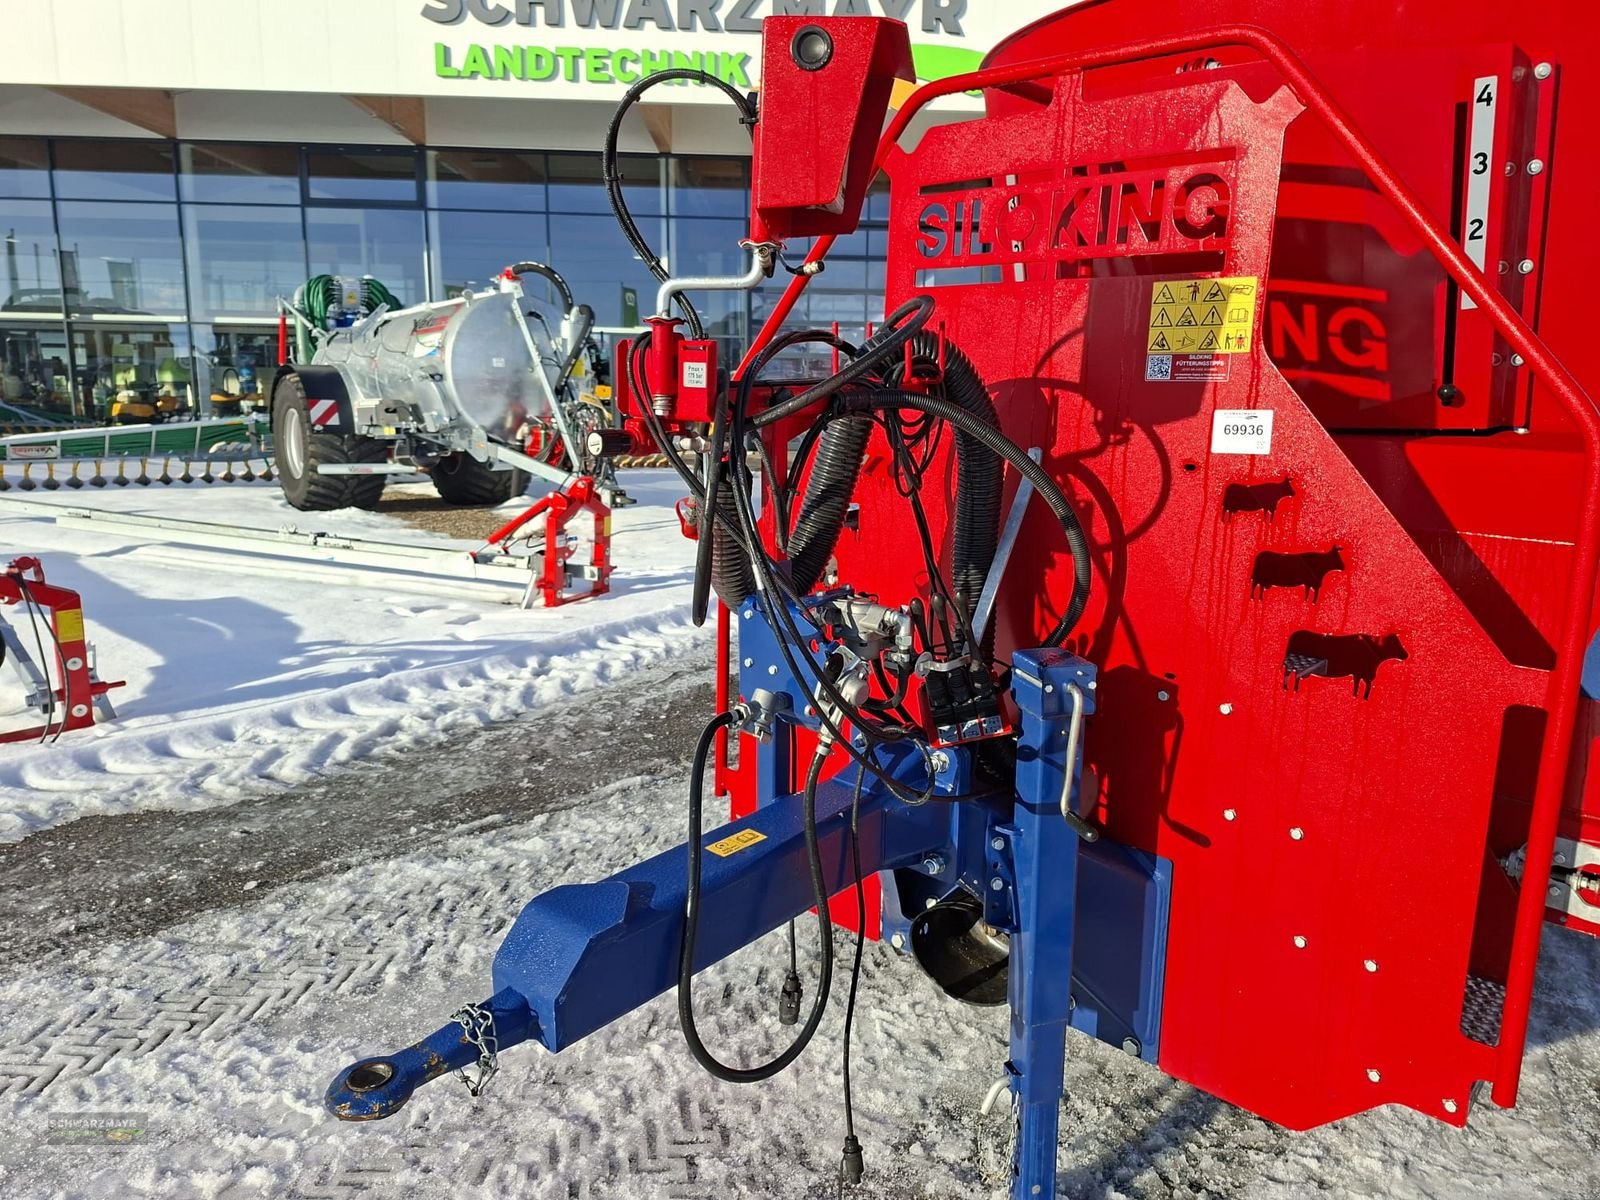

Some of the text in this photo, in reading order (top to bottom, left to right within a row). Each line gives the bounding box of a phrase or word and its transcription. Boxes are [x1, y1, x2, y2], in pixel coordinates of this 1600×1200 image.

[434, 42, 750, 86] LANDTECHNIK
[1476, 83, 1493, 107] 4
[1472, 152, 1488, 175] 3
[915, 172, 1233, 259] SILOKING
[1468, 218, 1484, 241] 2
[1223, 424, 1264, 436] 69936
